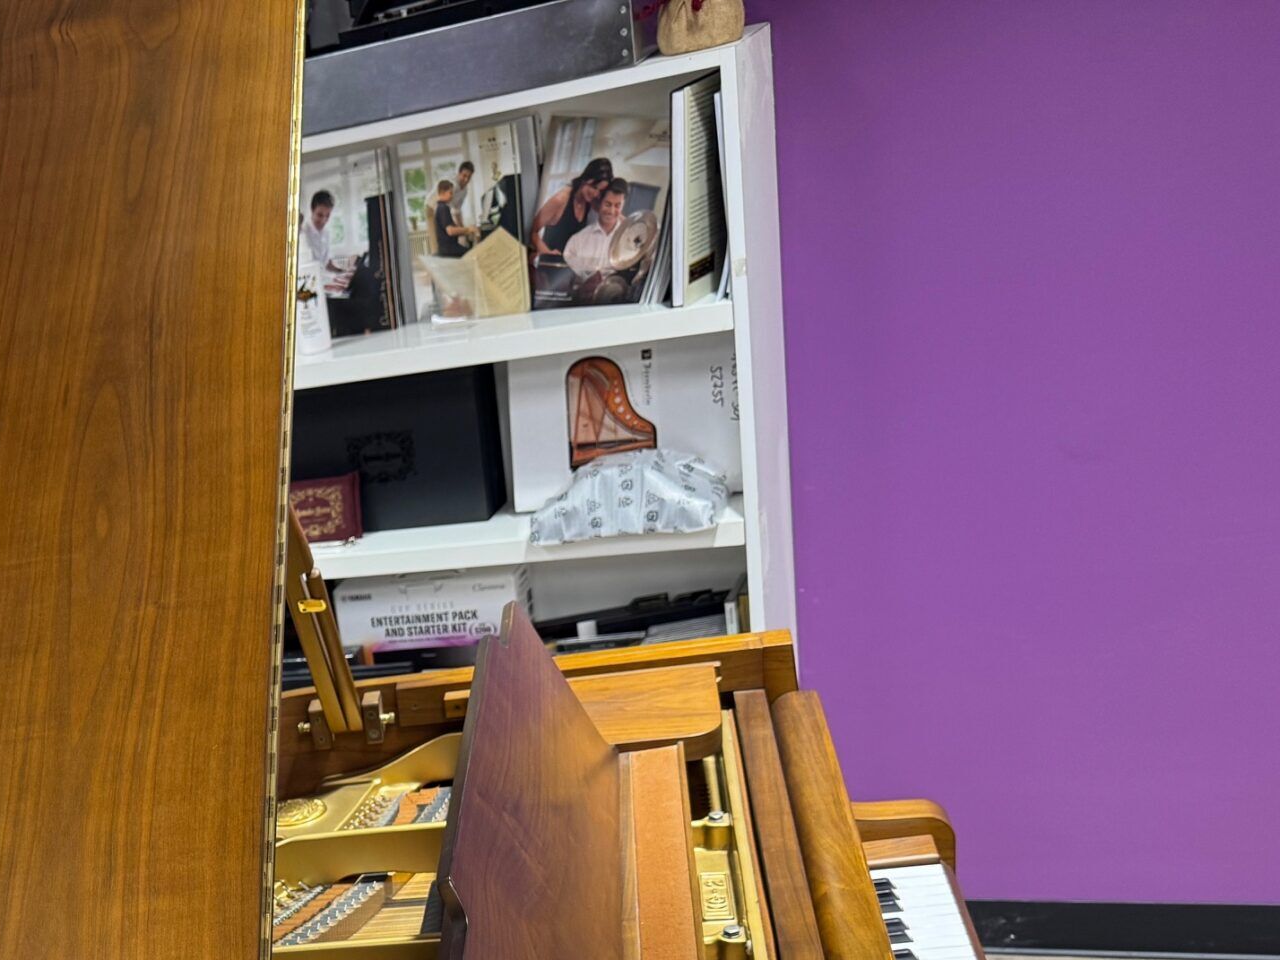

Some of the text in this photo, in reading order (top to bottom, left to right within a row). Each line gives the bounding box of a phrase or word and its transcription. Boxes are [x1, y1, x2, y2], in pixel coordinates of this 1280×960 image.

[371, 609, 479, 628] ENTERTAINMENT PACK
[384, 626, 405, 638] AND
[407, 624, 449, 637] STARTER
[451, 622, 467, 634] KIT
